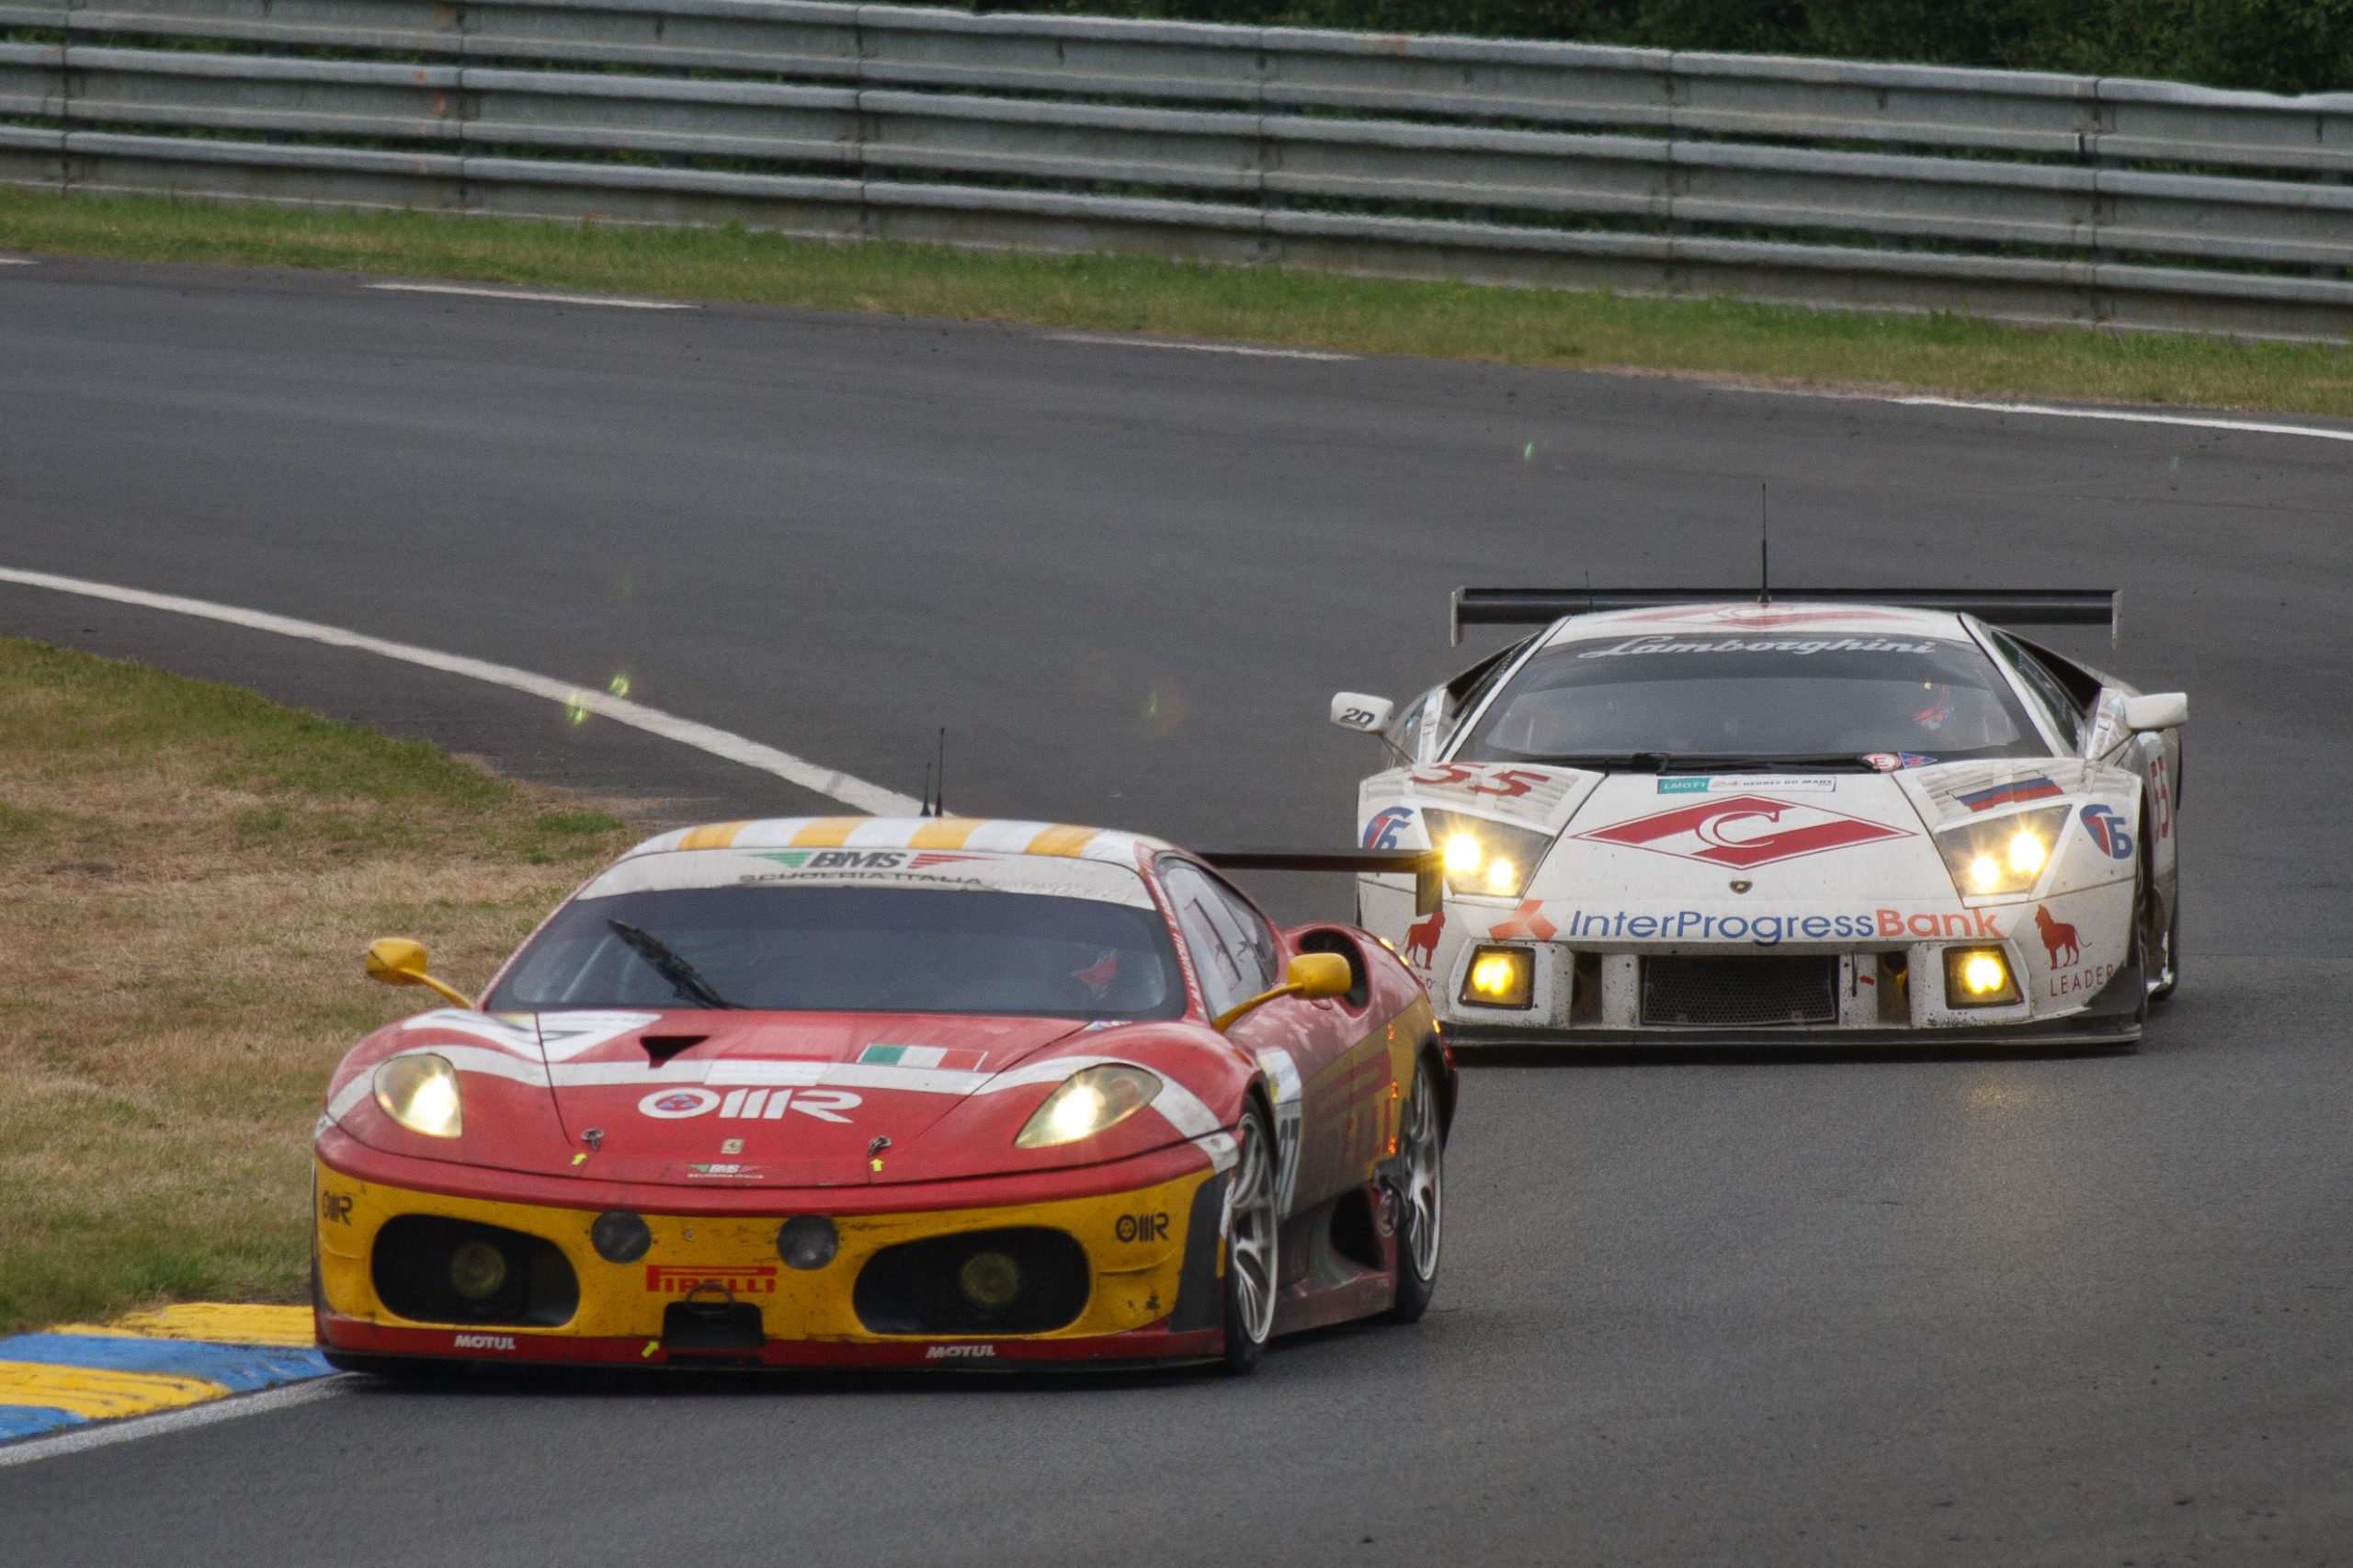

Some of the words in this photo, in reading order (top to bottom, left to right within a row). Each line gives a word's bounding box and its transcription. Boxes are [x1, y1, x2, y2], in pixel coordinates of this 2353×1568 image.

[1577, 635, 1936, 658] Lamborghini
[1409, 762, 1551, 798] 55
[807, 851, 907, 869] BMS
[738, 872, 887, 883] SCUDERIA
[895, 873, 983, 885] ITALIA
[1570, 907, 2004, 948] InterProgressBank
[2050, 963, 2115, 997] LEADER
[709, 1164, 741, 1174] BMS
[646, 1265, 778, 1293] PIRELLI
[454, 1335, 517, 1351] MOTUL
[925, 1344, 996, 1360] MOTUL
